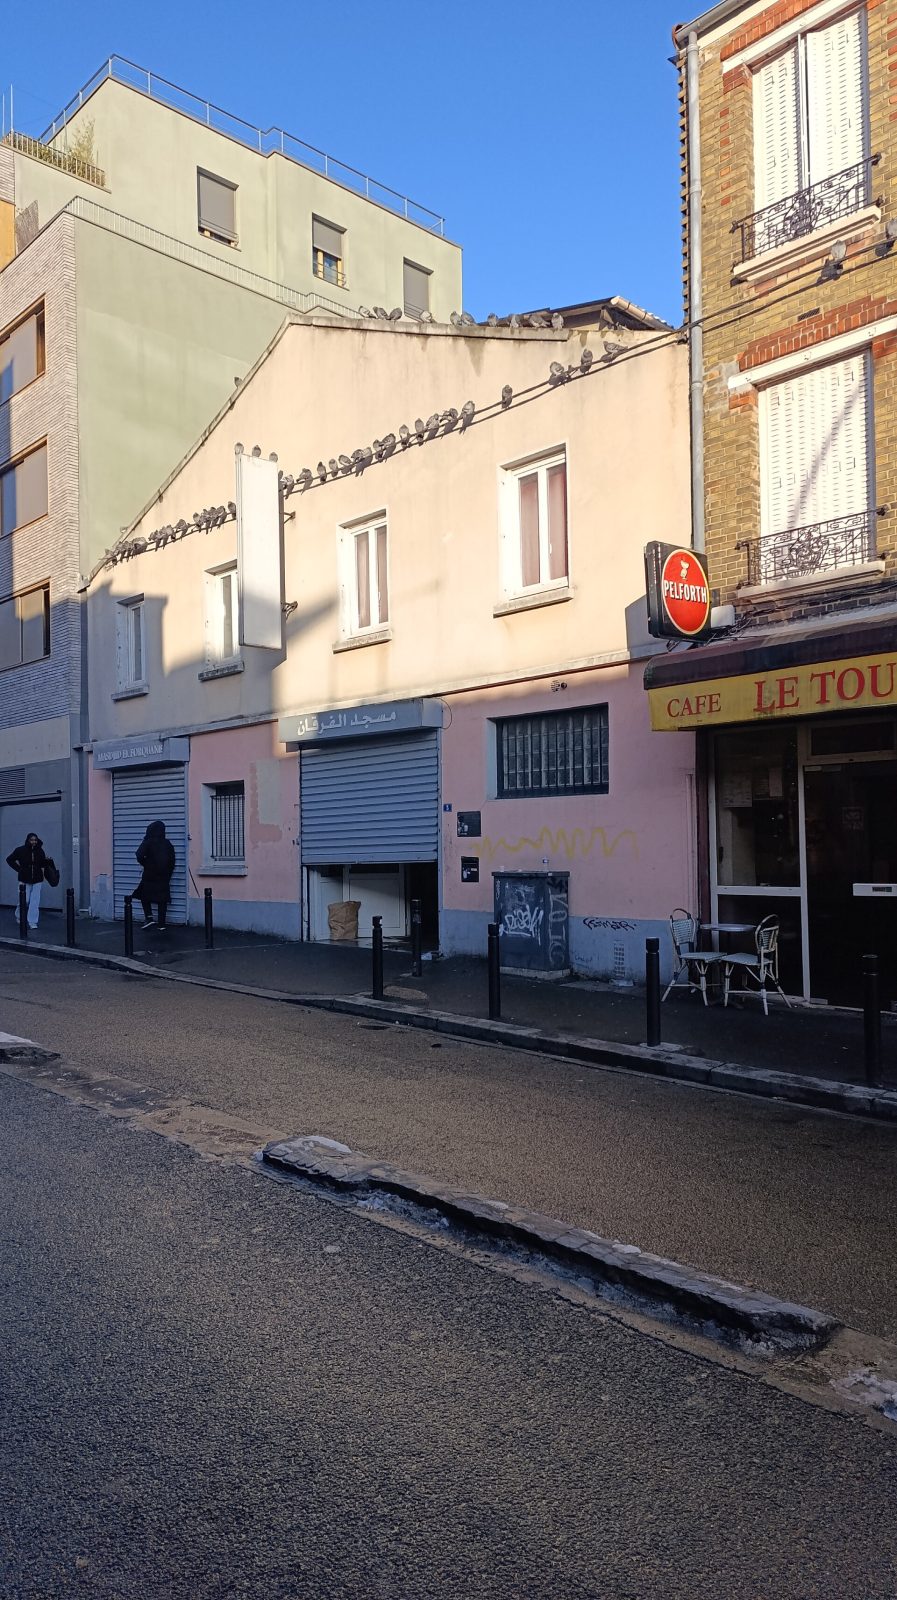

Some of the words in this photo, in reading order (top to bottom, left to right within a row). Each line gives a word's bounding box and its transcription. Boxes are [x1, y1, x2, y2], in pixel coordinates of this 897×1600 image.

[664, 580, 707, 603] PELFORTH
[667, 693, 721, 718] CAFE
[753, 676, 800, 713] LE
[810, 662, 897, 704] TOU
[297, 713, 346, 736] الفرقان
[350, 711, 397, 729] مسجد
